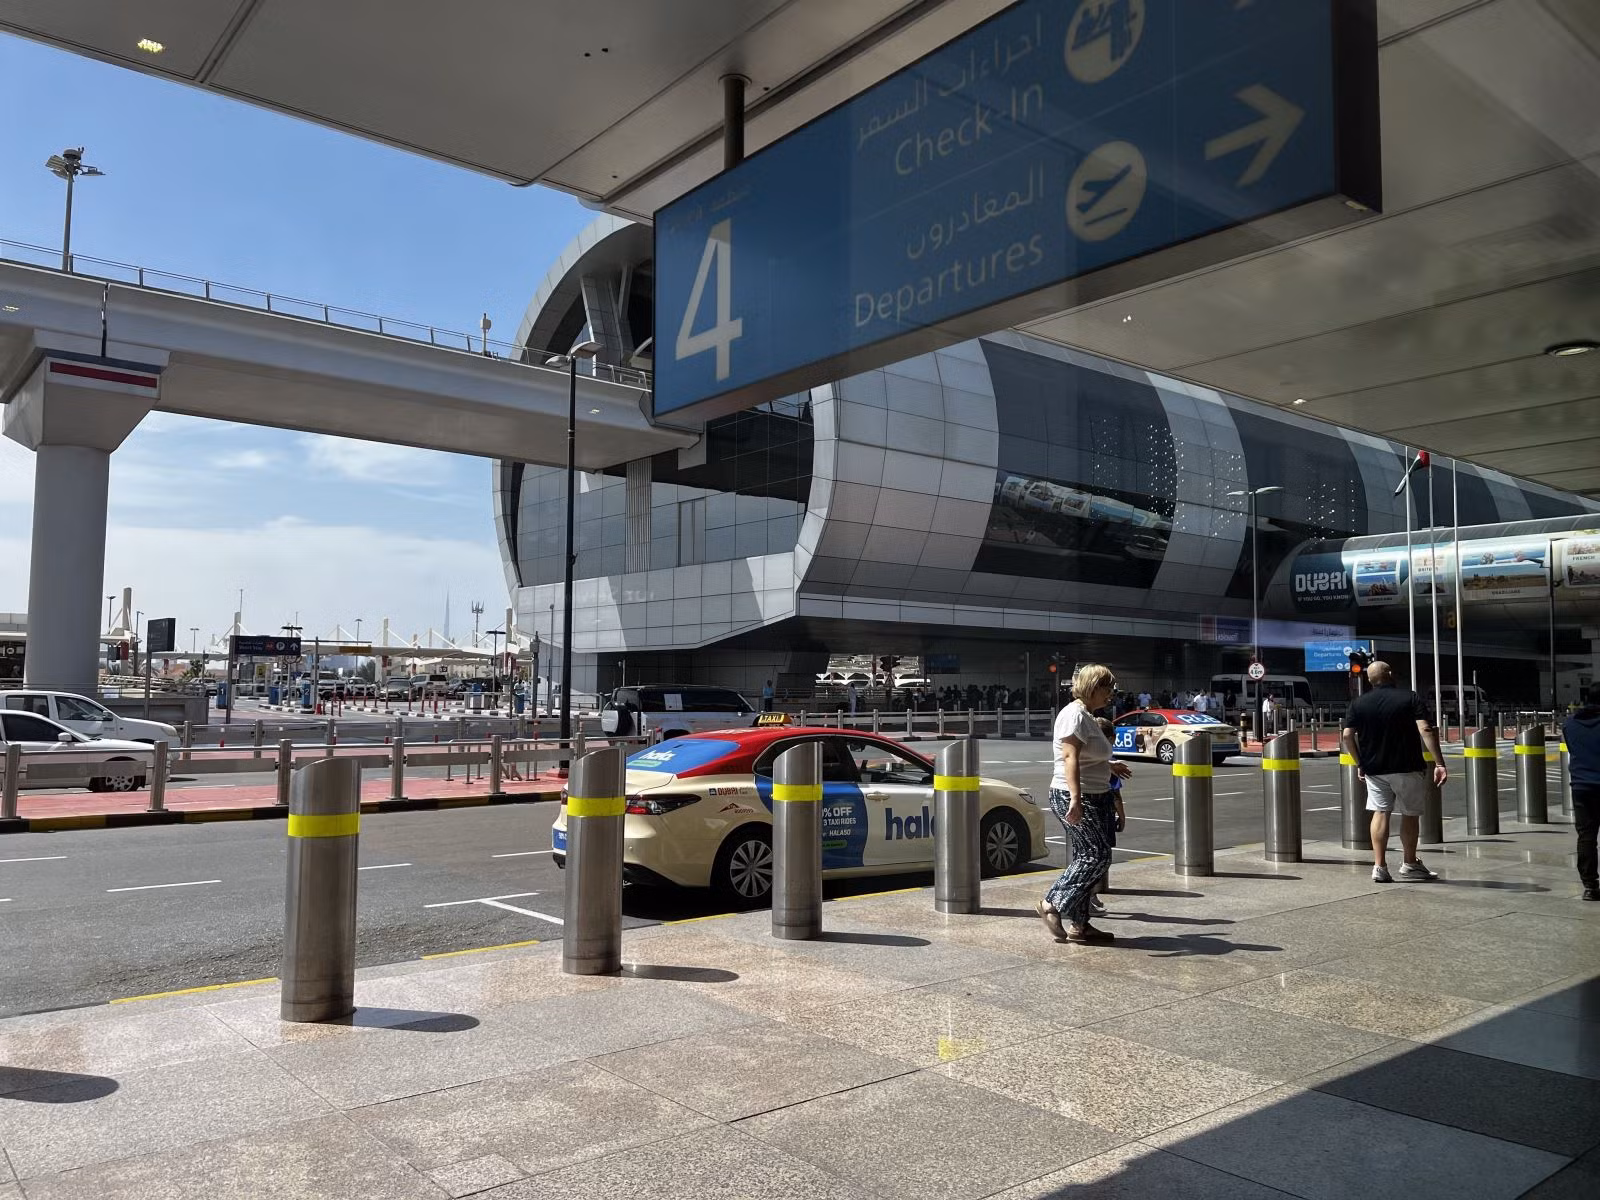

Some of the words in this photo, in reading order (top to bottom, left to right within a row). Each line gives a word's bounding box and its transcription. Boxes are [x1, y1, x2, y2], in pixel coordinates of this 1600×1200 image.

[894, 82, 1045, 176] Check-In
[853, 233, 1046, 329] Departures
[674, 217, 744, 382] 4
[1295, 571, 1348, 593] DUBAI
[764, 714, 781, 722] TAXI
[1112, 732, 1133, 748] &B
[828, 818, 840, 826] TAXI
[841, 817, 857, 825] RIDES
[832, 806, 854, 817] OFF
[884, 805, 935, 841] hal
